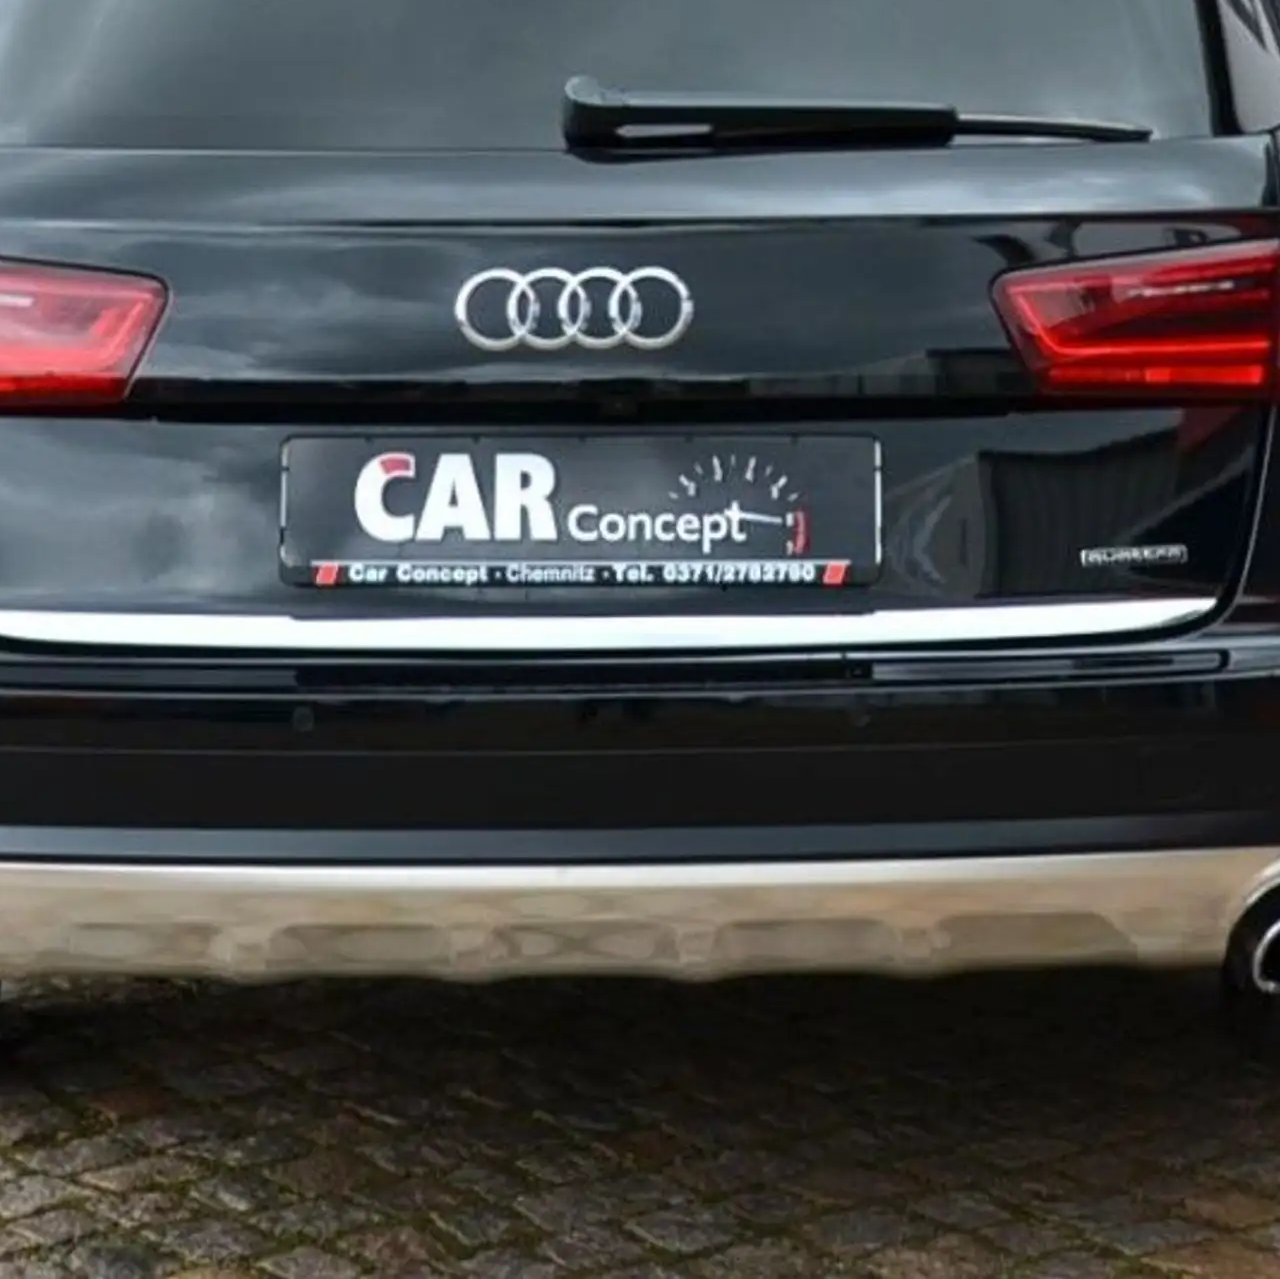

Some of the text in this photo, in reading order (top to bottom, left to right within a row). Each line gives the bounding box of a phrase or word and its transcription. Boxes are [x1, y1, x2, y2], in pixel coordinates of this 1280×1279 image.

[354, 452, 748, 553] CAR Concept
[349, 562, 388, 583] Car
[396, 562, 488, 586] Concept
[506, 562, 595, 583] Chemnitz
[612, 561, 654, 583] Tel.
